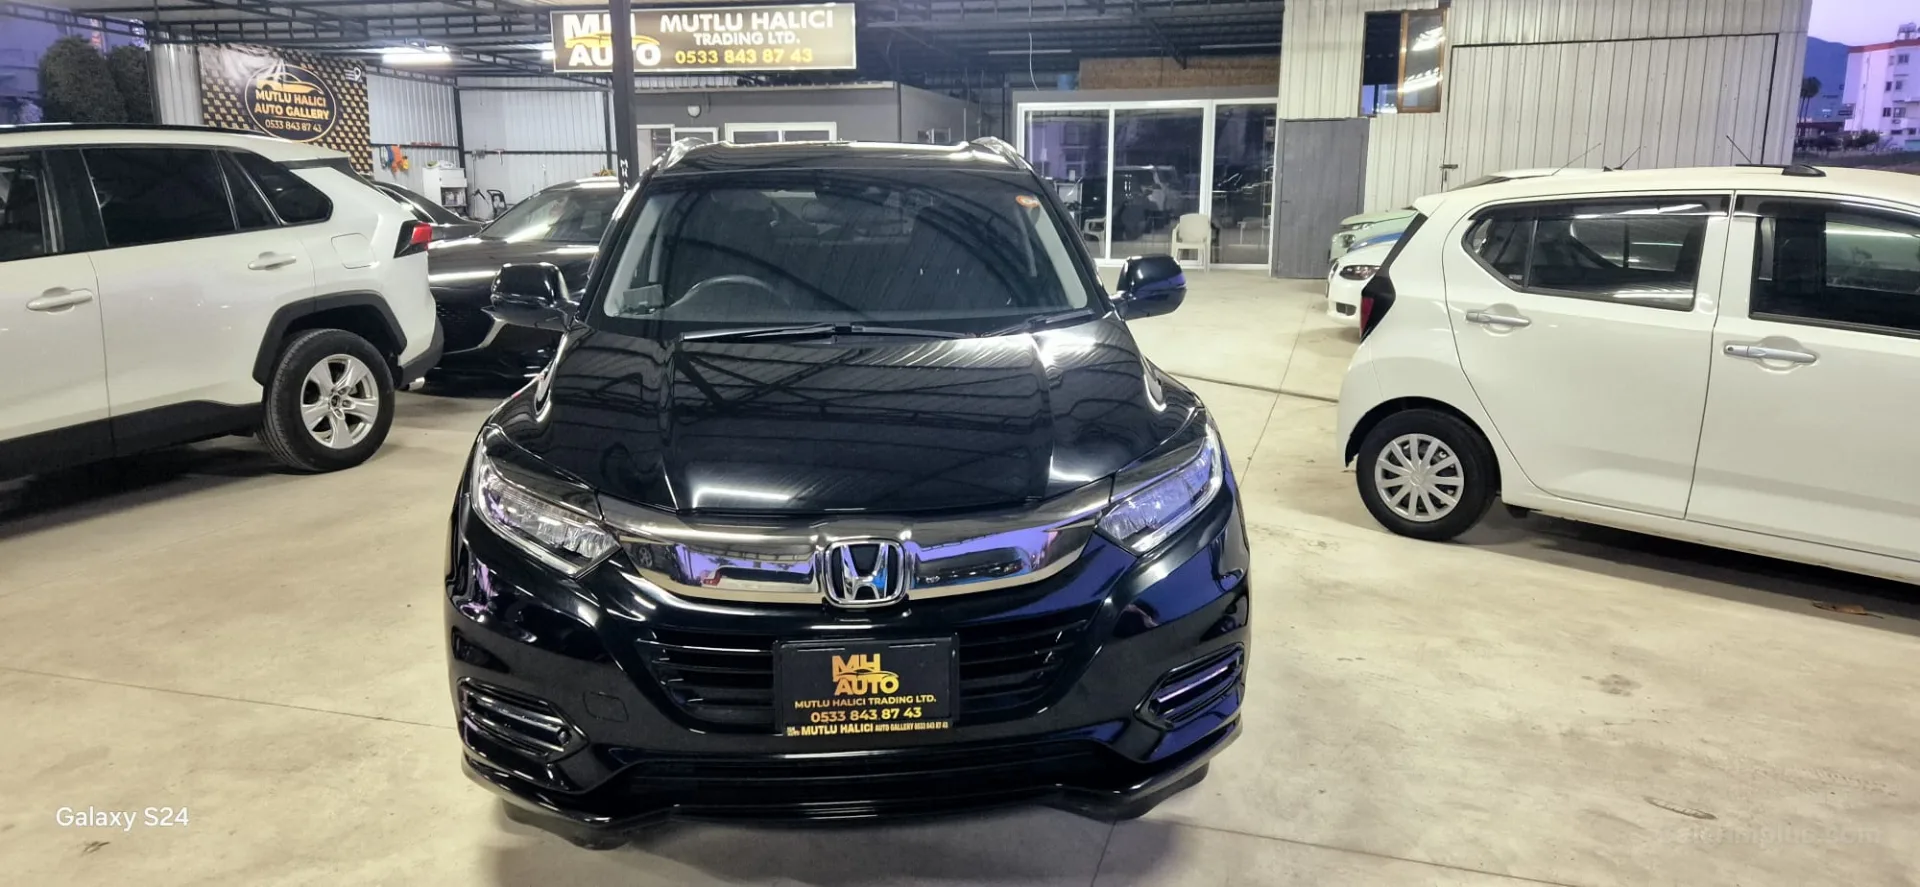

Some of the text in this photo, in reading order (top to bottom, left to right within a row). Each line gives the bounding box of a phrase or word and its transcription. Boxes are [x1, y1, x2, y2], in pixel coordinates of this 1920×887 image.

[660, 10, 833, 33] MUTLU HALICI
[693, 31, 801, 46] TRADING LTD.
[569, 43, 661, 67] AUO
[675, 48, 813, 64] 0533 843 87 43
[255, 89, 327, 107] MUTLU HALICI
[254, 103, 330, 120] AUTO GALLERY
[265, 119, 322, 133] 0533 843 87 43
[832, 653, 881, 681] MH
[834, 676, 899, 696] AUTO
[794, 694, 937, 709] MUTLU HALICI TRADING LTD.
[811, 707, 922, 723] 0533 843 87 43
[801, 724, 838, 736] MUTLU
[840, 723, 873, 734] HALICI
[875, 724, 889, 732] AUTO
[890, 723, 914, 731] GALLERY
